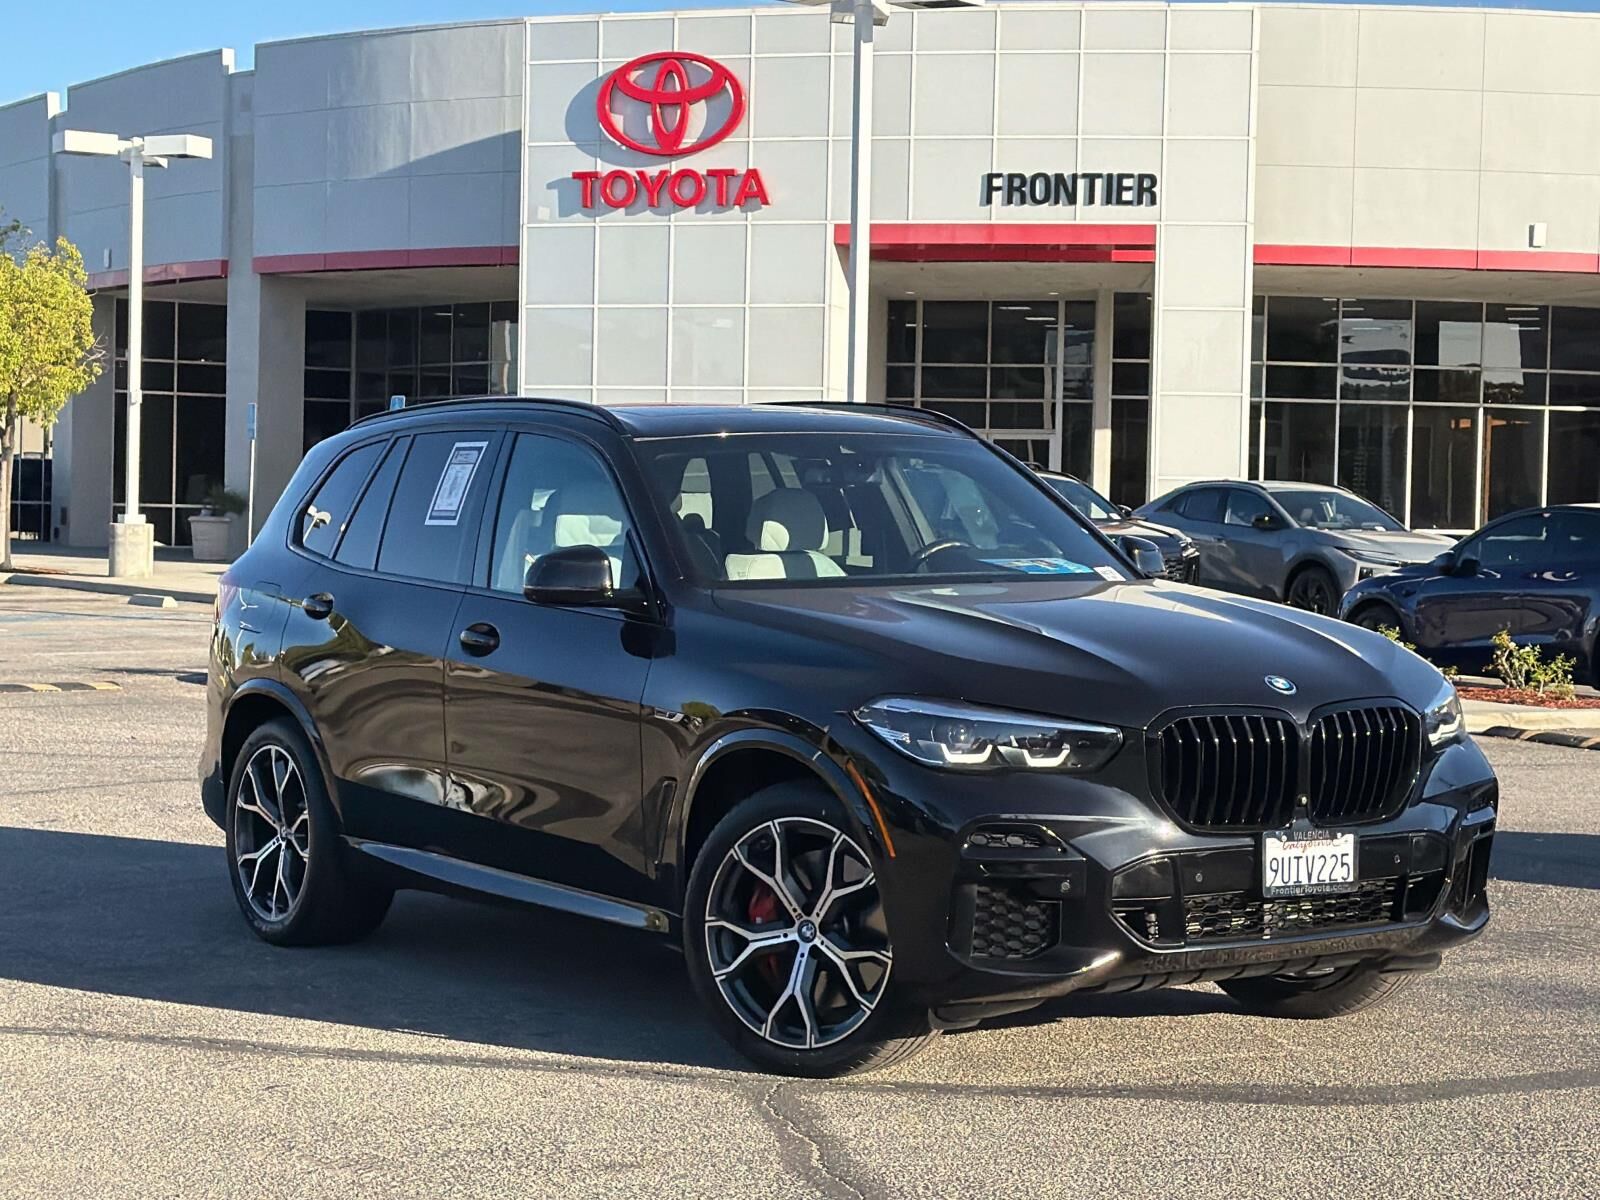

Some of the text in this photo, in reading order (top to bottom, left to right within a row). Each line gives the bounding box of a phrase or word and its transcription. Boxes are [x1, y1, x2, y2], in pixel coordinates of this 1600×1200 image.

[572, 168, 769, 208] TOYOTA
[986, 173, 1157, 206] FRONTIER
[1293, 830, 1330, 840] VALENCIA
[1269, 853, 1351, 886] 9UIV225
